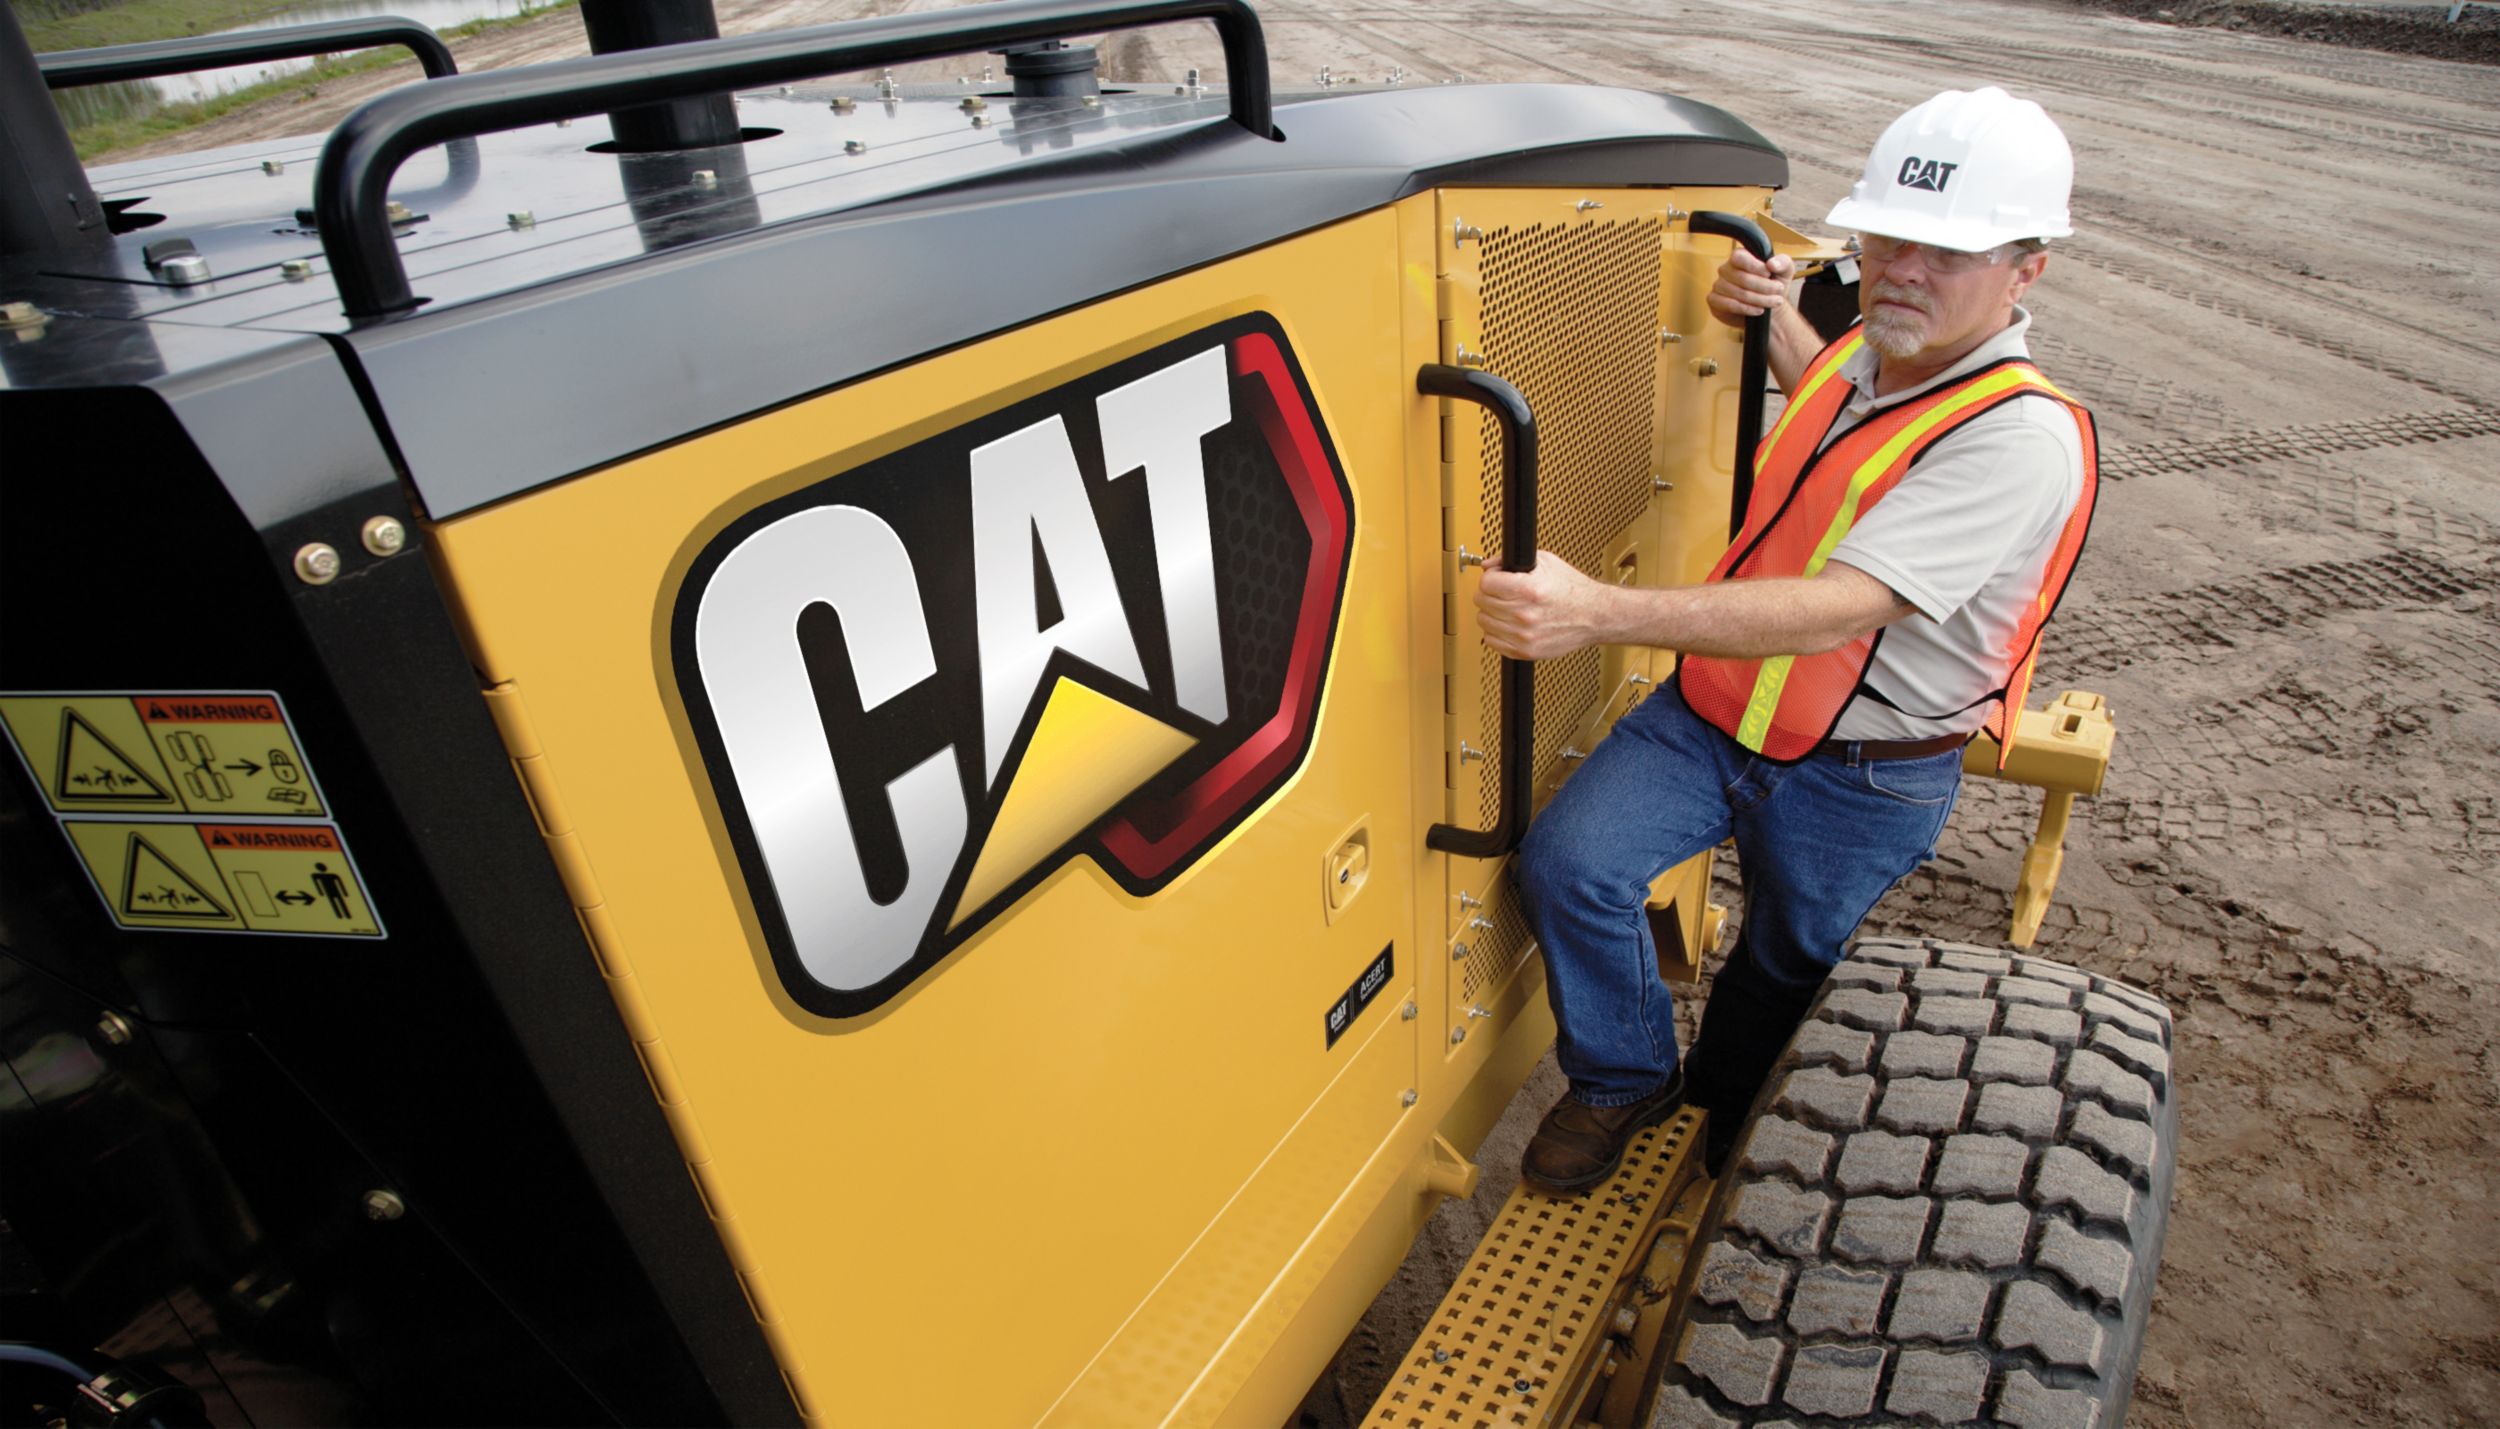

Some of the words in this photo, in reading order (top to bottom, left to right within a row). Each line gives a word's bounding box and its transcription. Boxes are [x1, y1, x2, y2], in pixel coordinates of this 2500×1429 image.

[1897, 155, 1959, 193] CAT
[696, 344, 1231, 991] CAT
[170, 703, 274, 720] WARNING
[233, 831, 334, 849] WARNING
[1360, 958, 1386, 996] ACERT
[1330, 999, 1348, 1029] CAT
